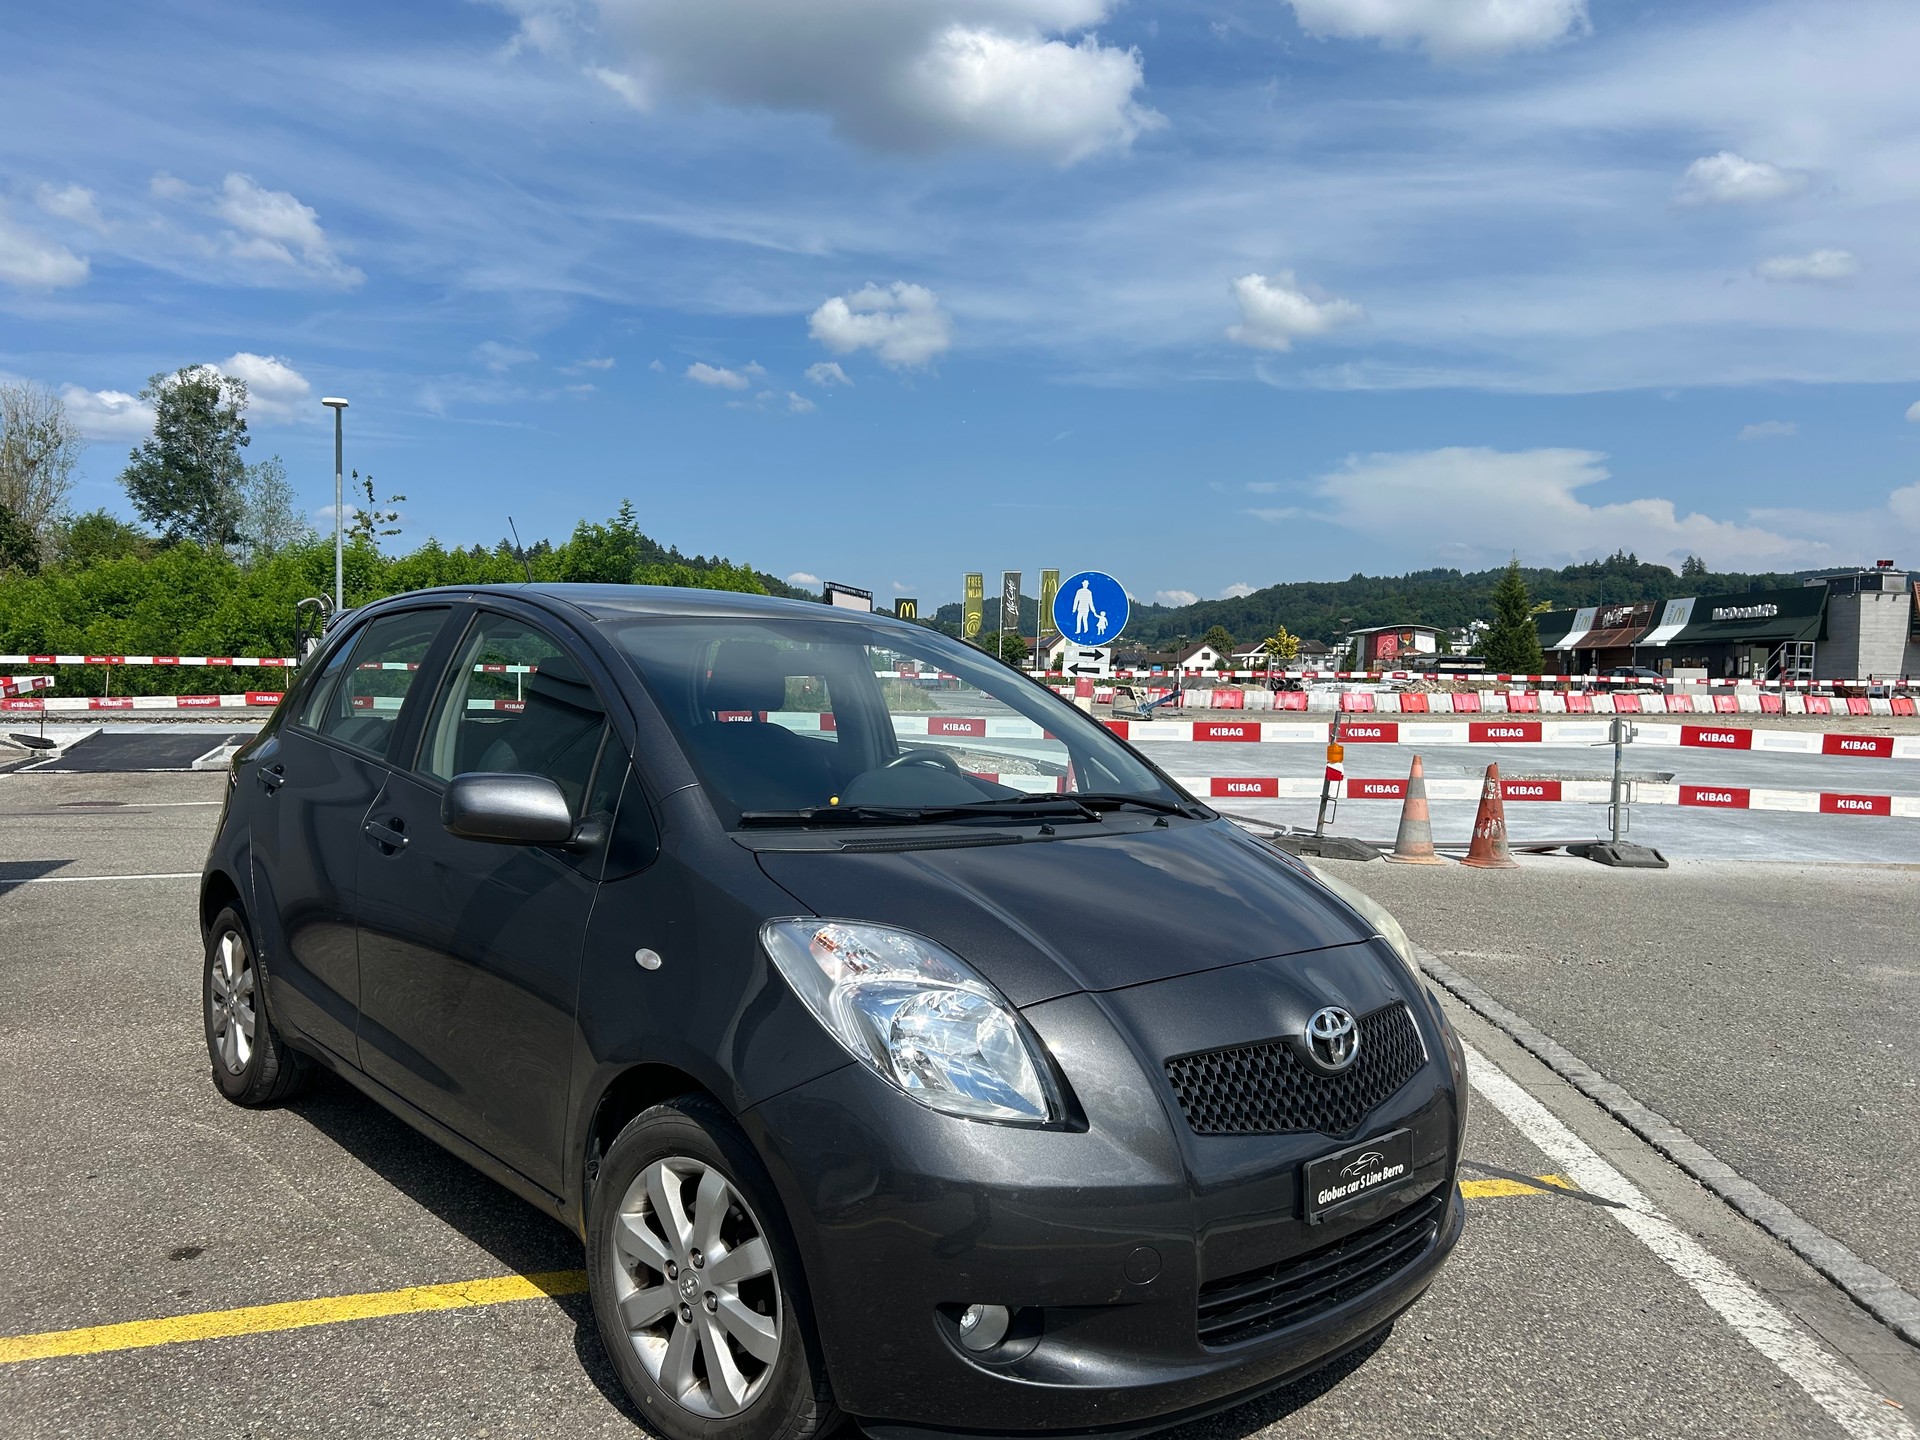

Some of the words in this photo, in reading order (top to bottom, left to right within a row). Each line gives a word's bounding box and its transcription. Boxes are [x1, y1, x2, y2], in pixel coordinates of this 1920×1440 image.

[967, 576, 981, 587] FREE
[1712, 604, 1777, 620] McDonald's
[943, 723, 971, 732] KIBAG
[1209, 728, 1243, 736] KIBAG
[1346, 728, 1381, 737] KIBAG
[1487, 728, 1523, 737] KIBAG
[1699, 732, 1735, 744] KIBAG
[1841, 740, 1876, 751] KIBAG
[1227, 783, 1261, 792] KIBAG
[1364, 784, 1400, 794] KIBAG
[1506, 786, 1543, 795] KIBAG
[1696, 791, 1732, 803] KIBAG
[1837, 799, 1872, 810] KIBAG
[1318, 1186, 1346, 1204] Globus
[1347, 1180, 1360, 1193] car
[1360, 1175, 1366, 1189] S
[1366, 1172, 1381, 1186] Line
[1383, 1164, 1404, 1180] Berro
